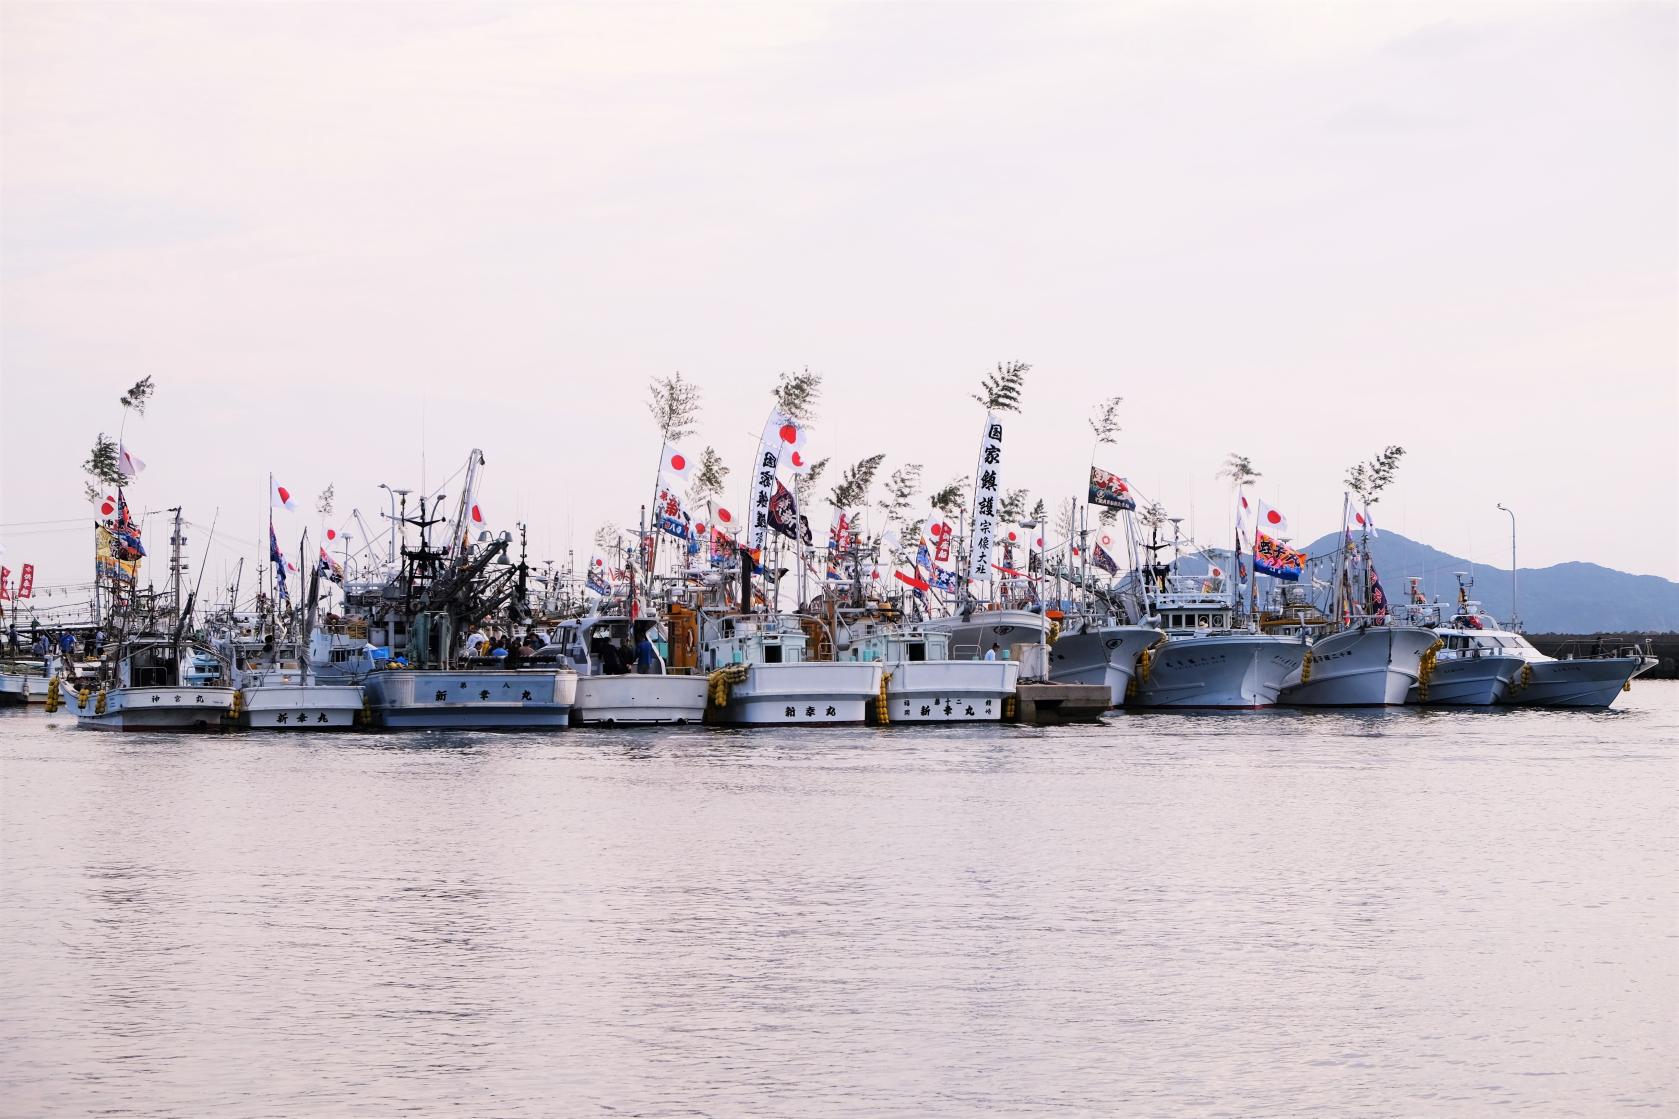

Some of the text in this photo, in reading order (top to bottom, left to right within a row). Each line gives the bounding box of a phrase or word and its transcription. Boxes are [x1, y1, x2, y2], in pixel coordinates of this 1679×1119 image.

[975, 424, 1002, 574] 国家鎮護宗像大社
[151, 694, 204, 703] 神宮丸
[920, 705, 975, 716] 新幸丸
[276, 712, 329, 724] 新幸丸
